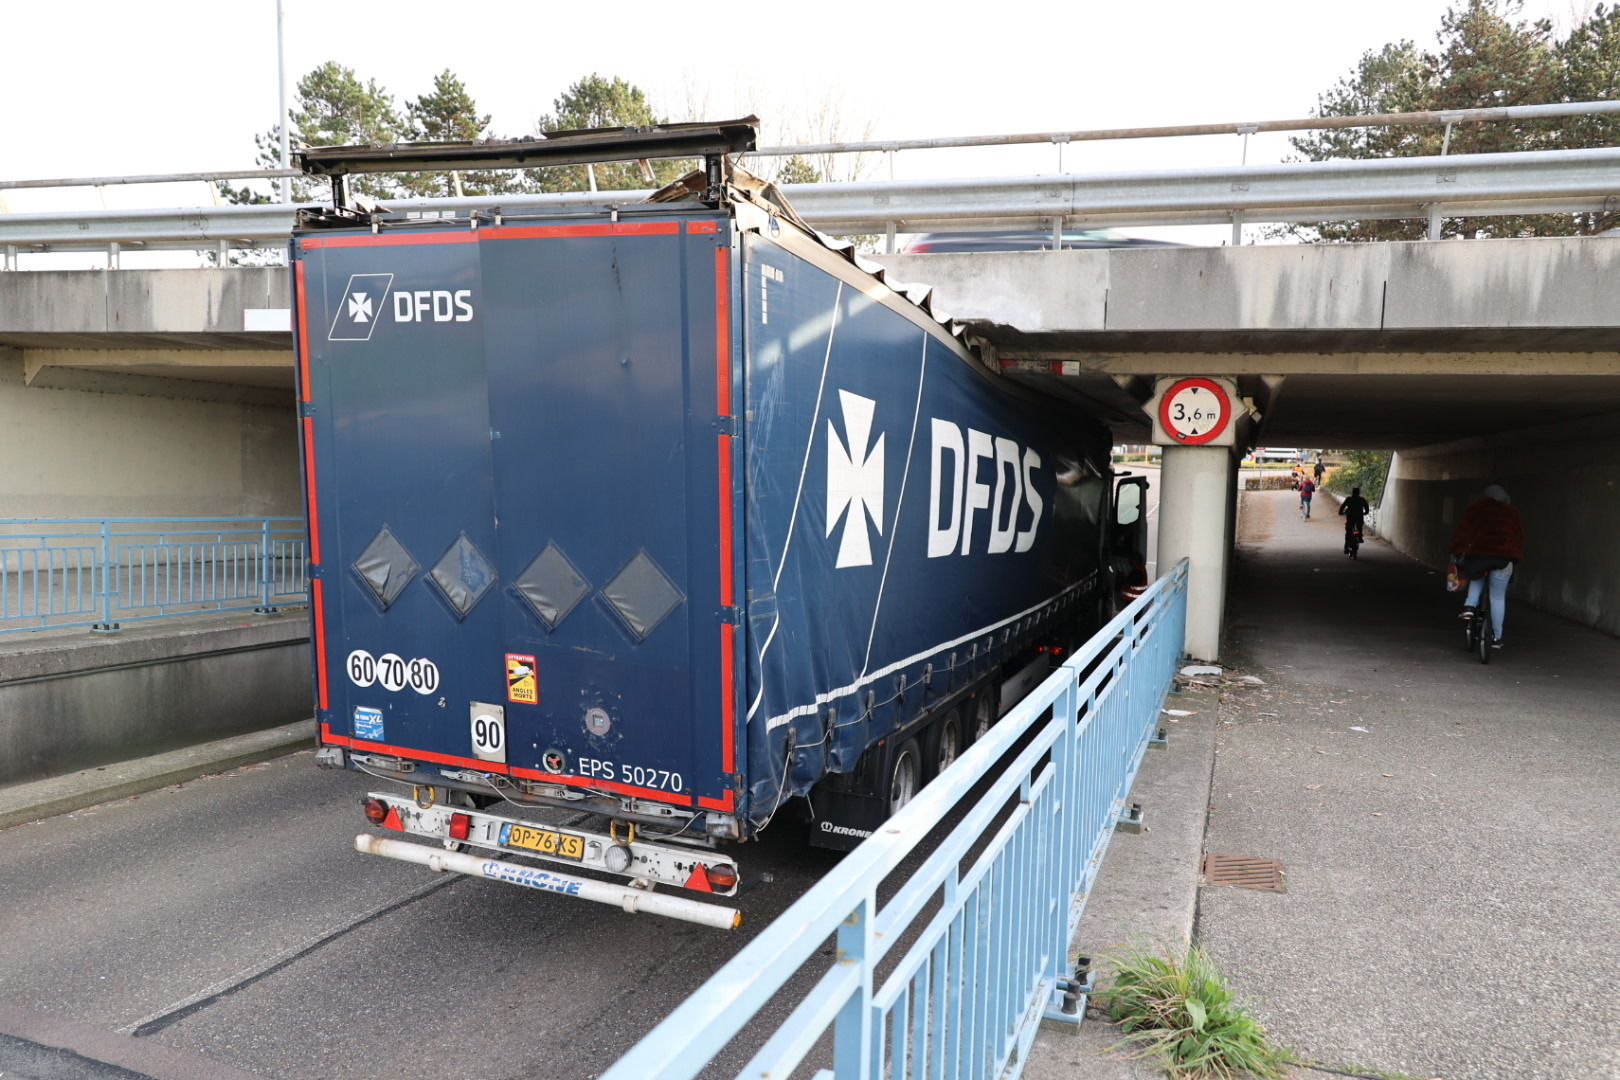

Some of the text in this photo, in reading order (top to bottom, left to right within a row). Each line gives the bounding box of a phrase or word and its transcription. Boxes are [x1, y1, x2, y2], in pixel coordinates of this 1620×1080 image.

[393, 290, 474, 322] DFDS
[1174, 403, 1202, 423] 3,6
[927, 417, 1043, 558] DFDS
[351, 655, 435, 690] 60 70 80
[512, 687, 534, 695] ANGLES
[369, 714, 382, 725] XL
[475, 719, 500, 749] 90
[579, 757, 683, 792] EPS 50270
[512, 828, 578, 854] OP-76KS
[832, 825, 873, 839] KRONE
